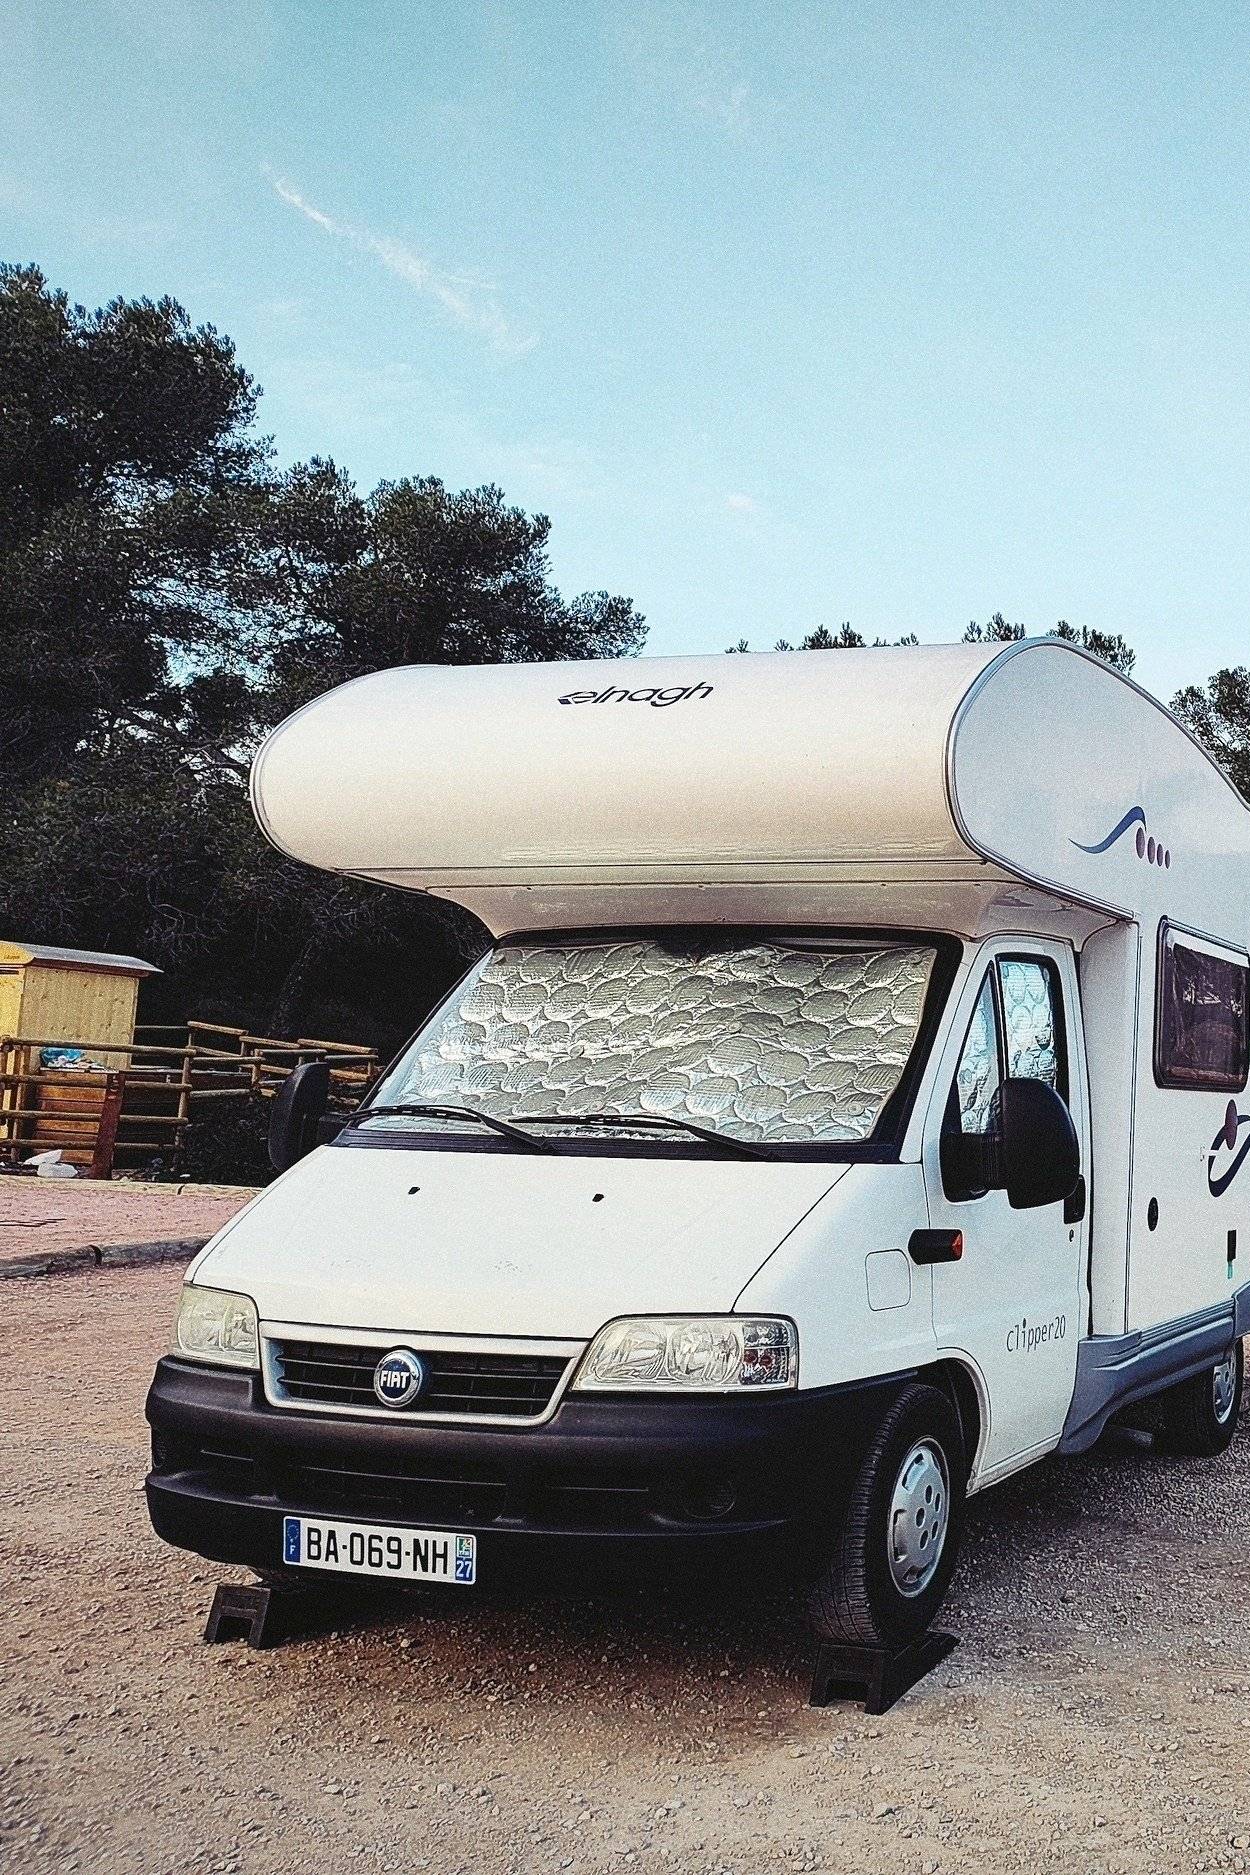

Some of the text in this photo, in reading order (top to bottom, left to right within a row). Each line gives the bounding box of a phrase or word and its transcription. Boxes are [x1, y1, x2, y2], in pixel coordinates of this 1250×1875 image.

[558, 682, 714, 707] elnagh
[1006, 1315, 1066, 1353] clipper20
[380, 1370, 410, 1389] FIAT
[290, 1545, 296, 1555] F
[306, 1526, 448, 1575] BA-069-NH
[456, 1560, 472, 1578] 27
